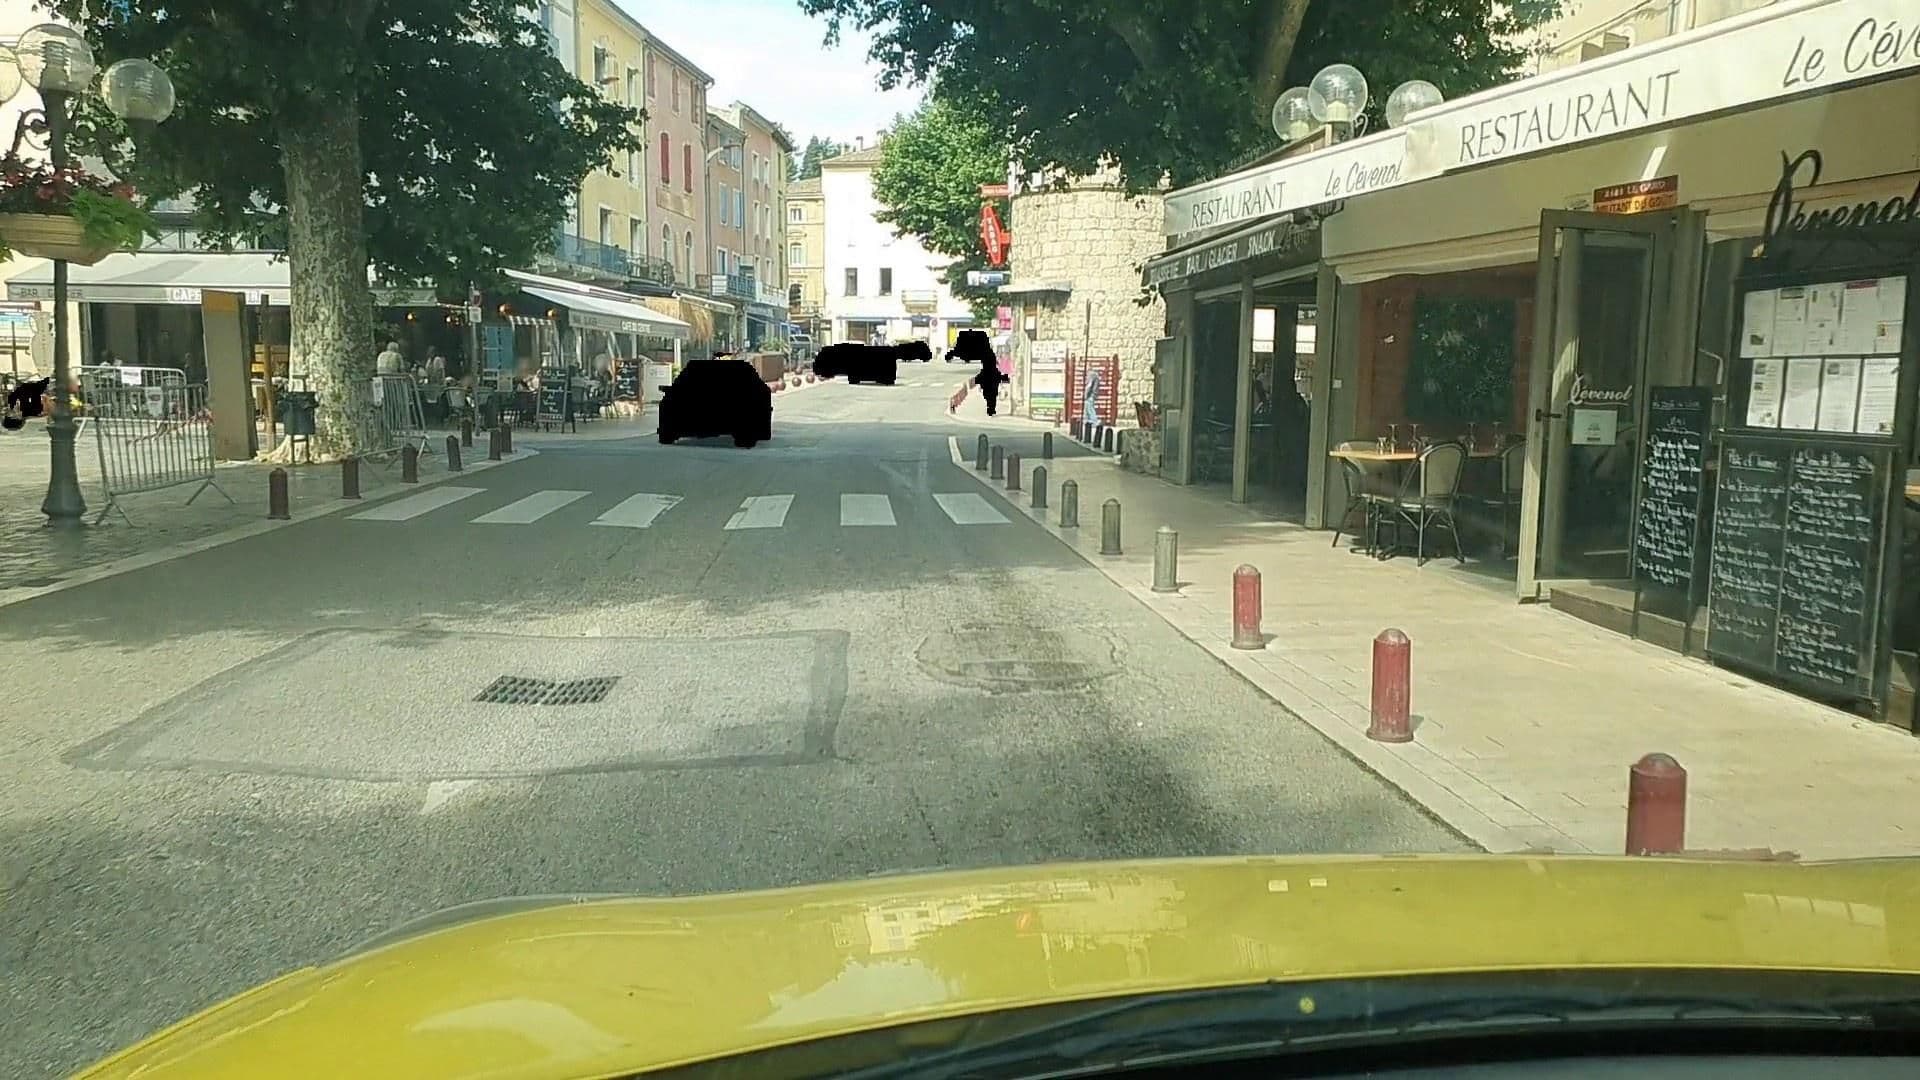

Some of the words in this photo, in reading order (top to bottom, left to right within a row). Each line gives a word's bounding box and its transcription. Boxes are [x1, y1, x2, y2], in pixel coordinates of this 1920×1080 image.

[1783, 36, 1825, 88] Le
[1843, 17, 1920, 73] Cév
[1459, 69, 1680, 162] RESTAURANT
[1325, 168, 1341, 197] Le
[1346, 155, 1403, 193] Cévenol
[1191, 181, 1287, 229] RESTAURANT
[987, 217, 999, 253] TABAC
[1248, 230, 1277, 258] SNACK
[1568, 372, 1633, 405] Cévenol
